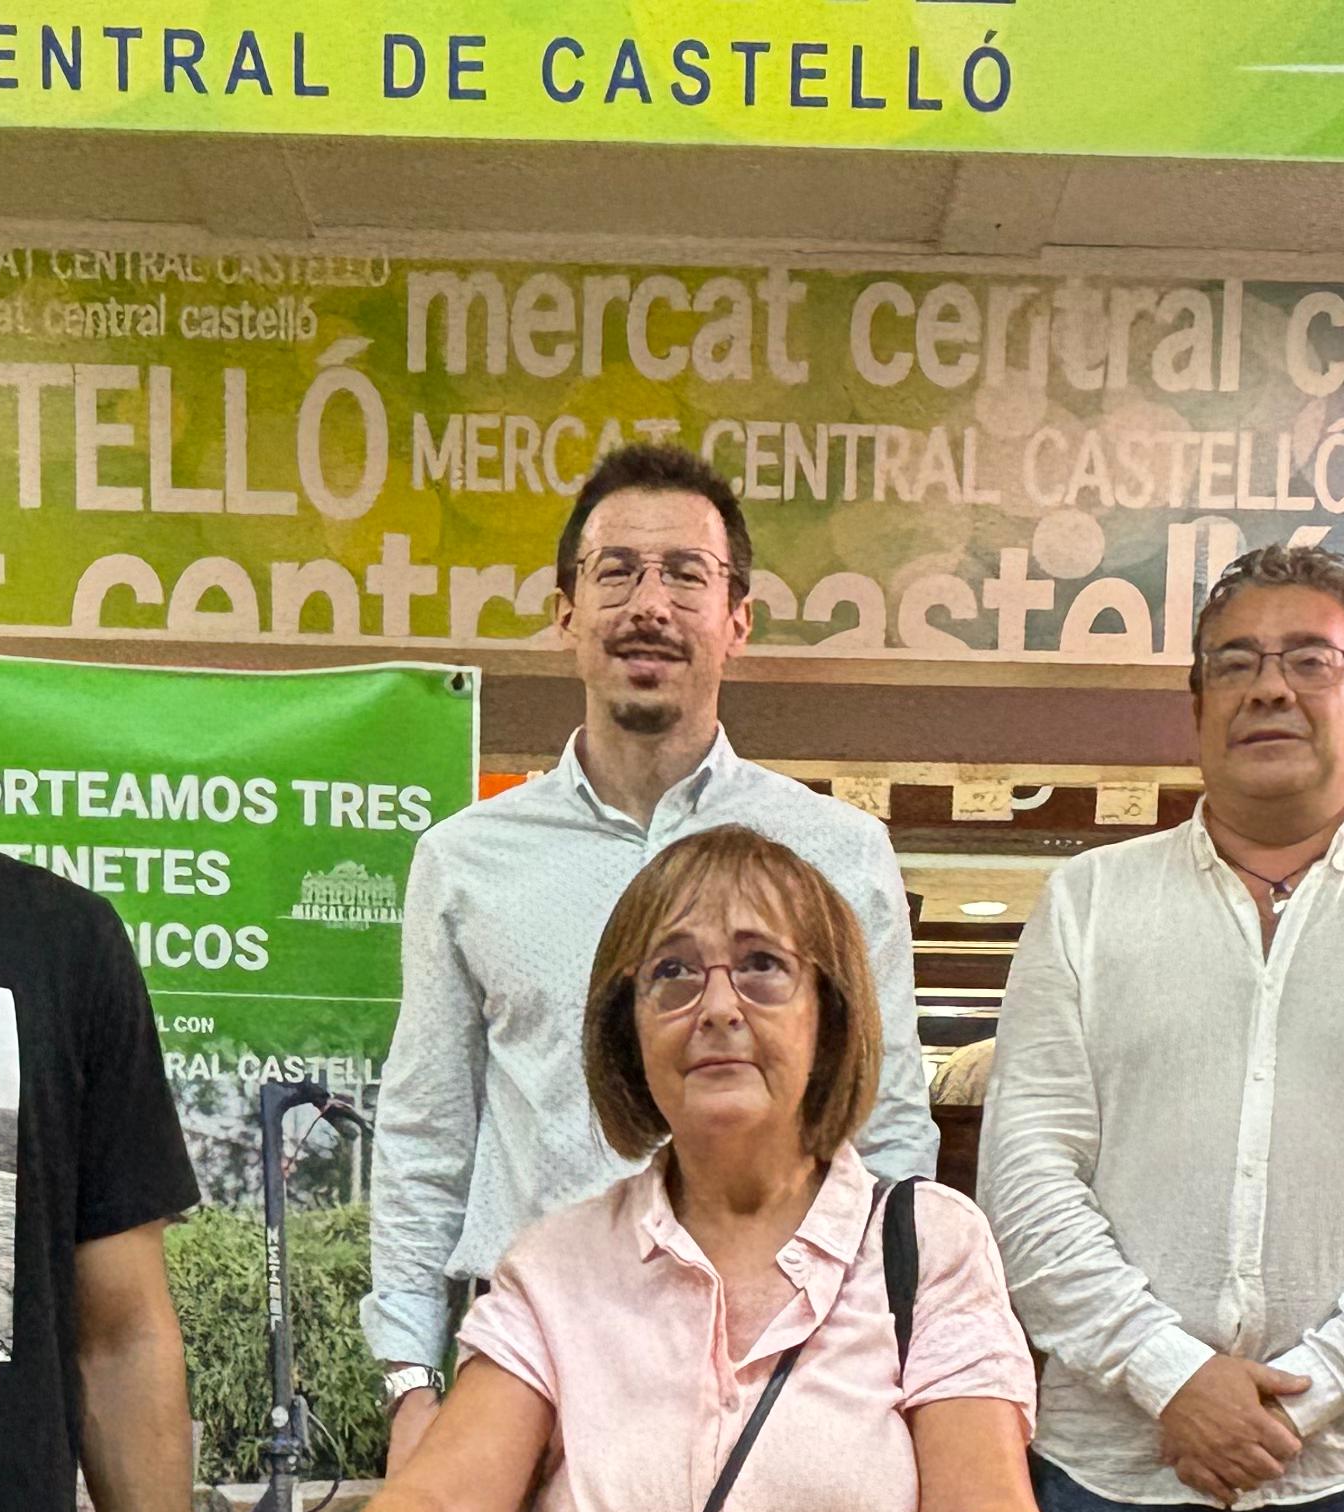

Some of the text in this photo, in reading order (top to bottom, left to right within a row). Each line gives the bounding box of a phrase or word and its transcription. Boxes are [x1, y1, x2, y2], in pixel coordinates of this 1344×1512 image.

[383, 33, 488, 101] DE
[542, 30, 1013, 113] CASTELLÓ
[45, 294, 166, 338] central
[407, 265, 807, 388] mercat
[854, 278, 1242, 396] central
[701, 419, 1003, 508] CENTRAL
[292, 779, 432, 832] TRES
[173, 1015, 215, 1034] CON
